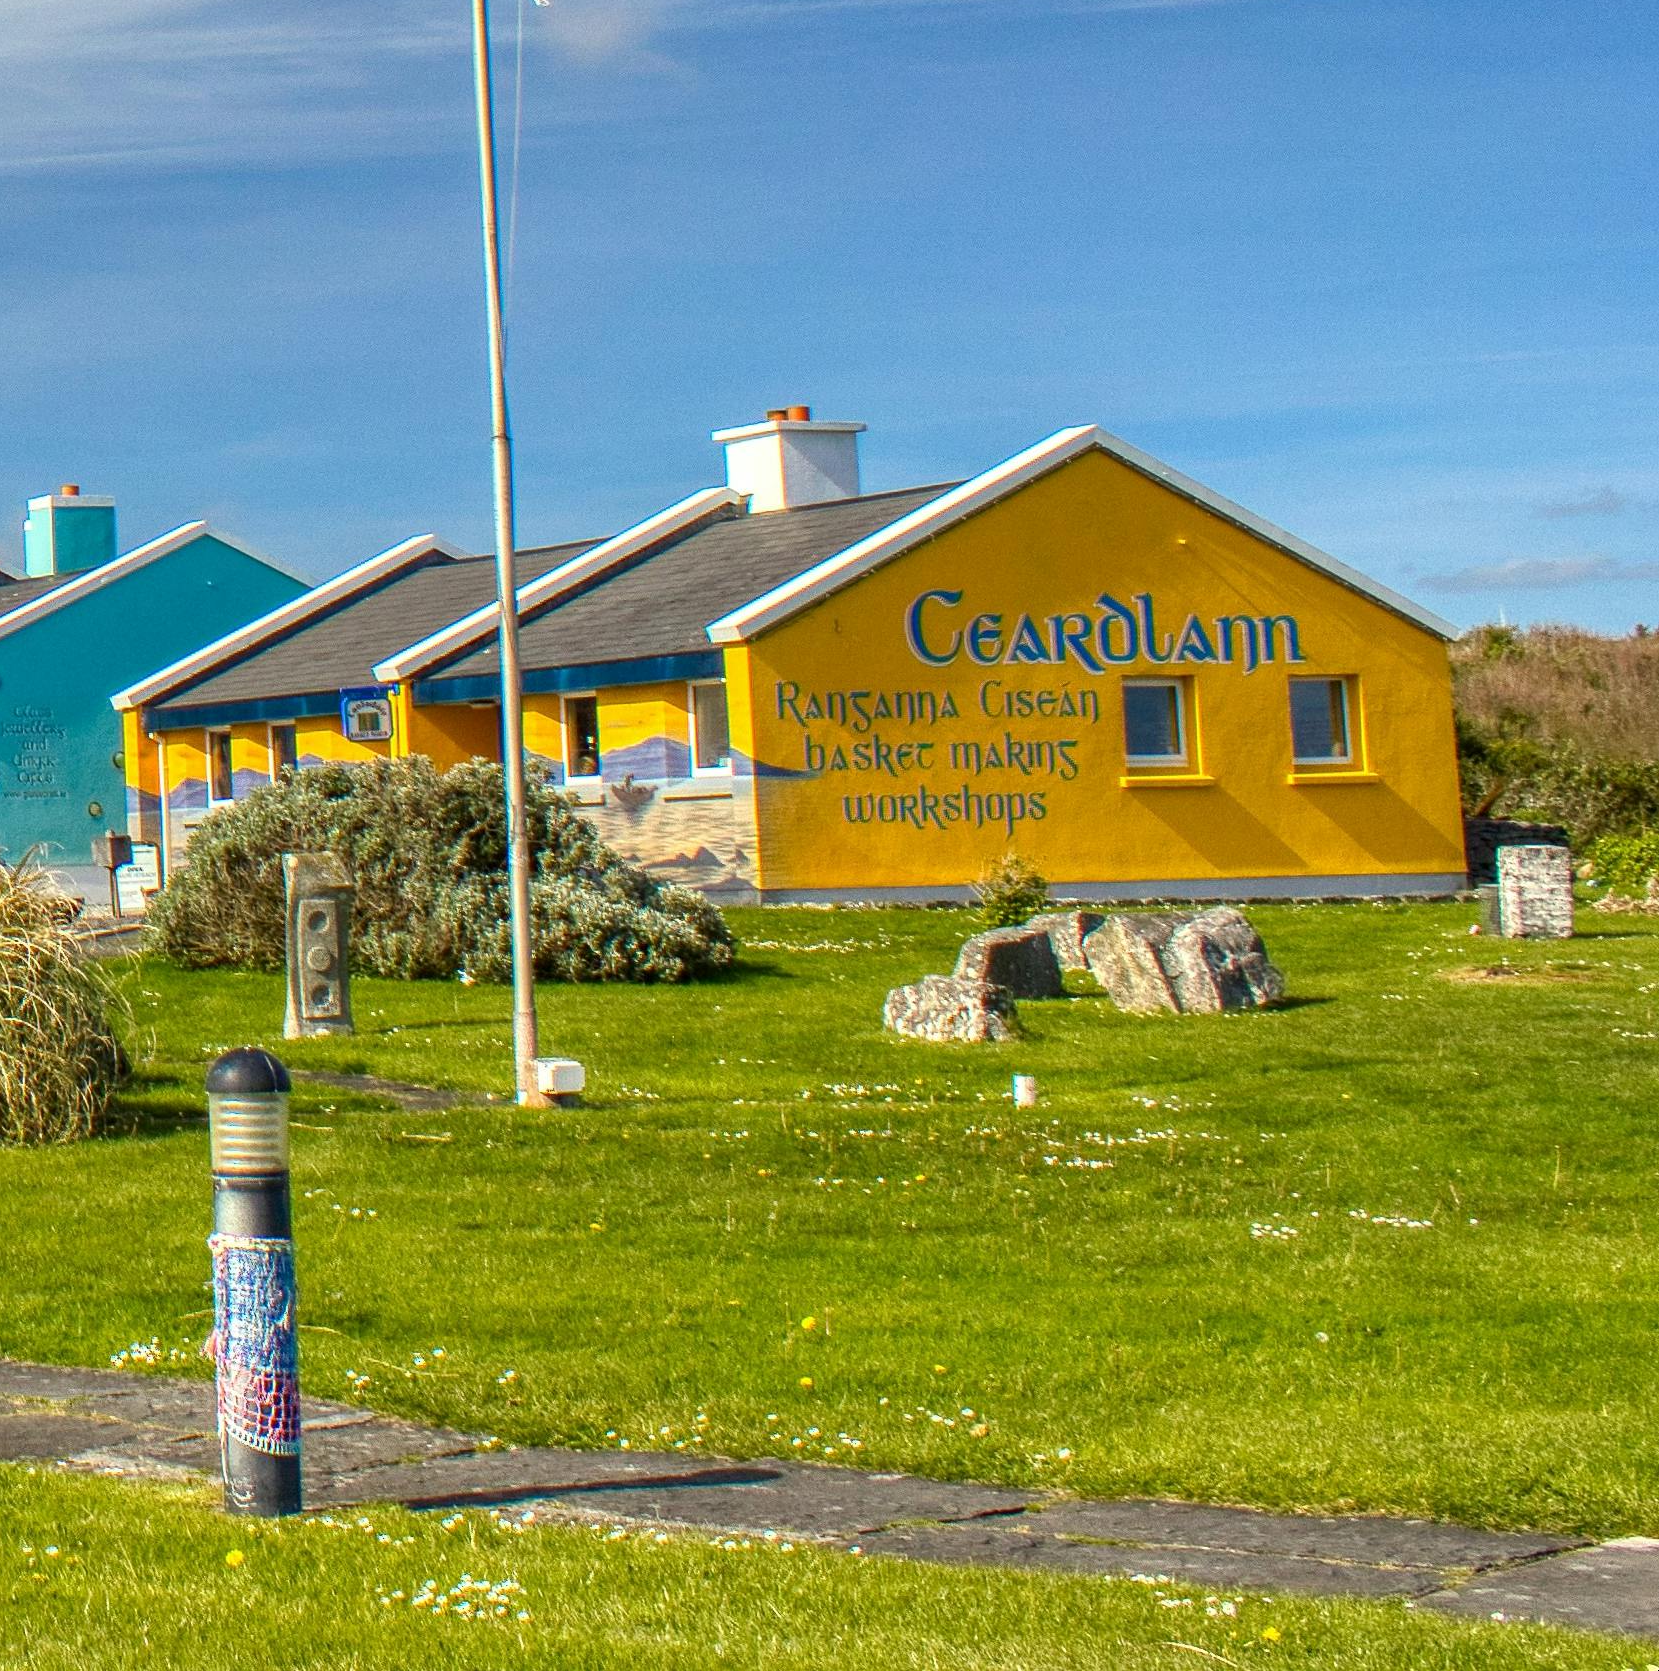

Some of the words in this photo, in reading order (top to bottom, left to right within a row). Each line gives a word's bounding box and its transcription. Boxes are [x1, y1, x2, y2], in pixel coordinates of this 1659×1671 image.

[775, 680, 959, 733] Ranganna
[978, 678, 1101, 724] Ciseán
[804, 732, 935, 778] basket
[950, 732, 1080, 780] making
[842, 784, 1048, 838] workshops
